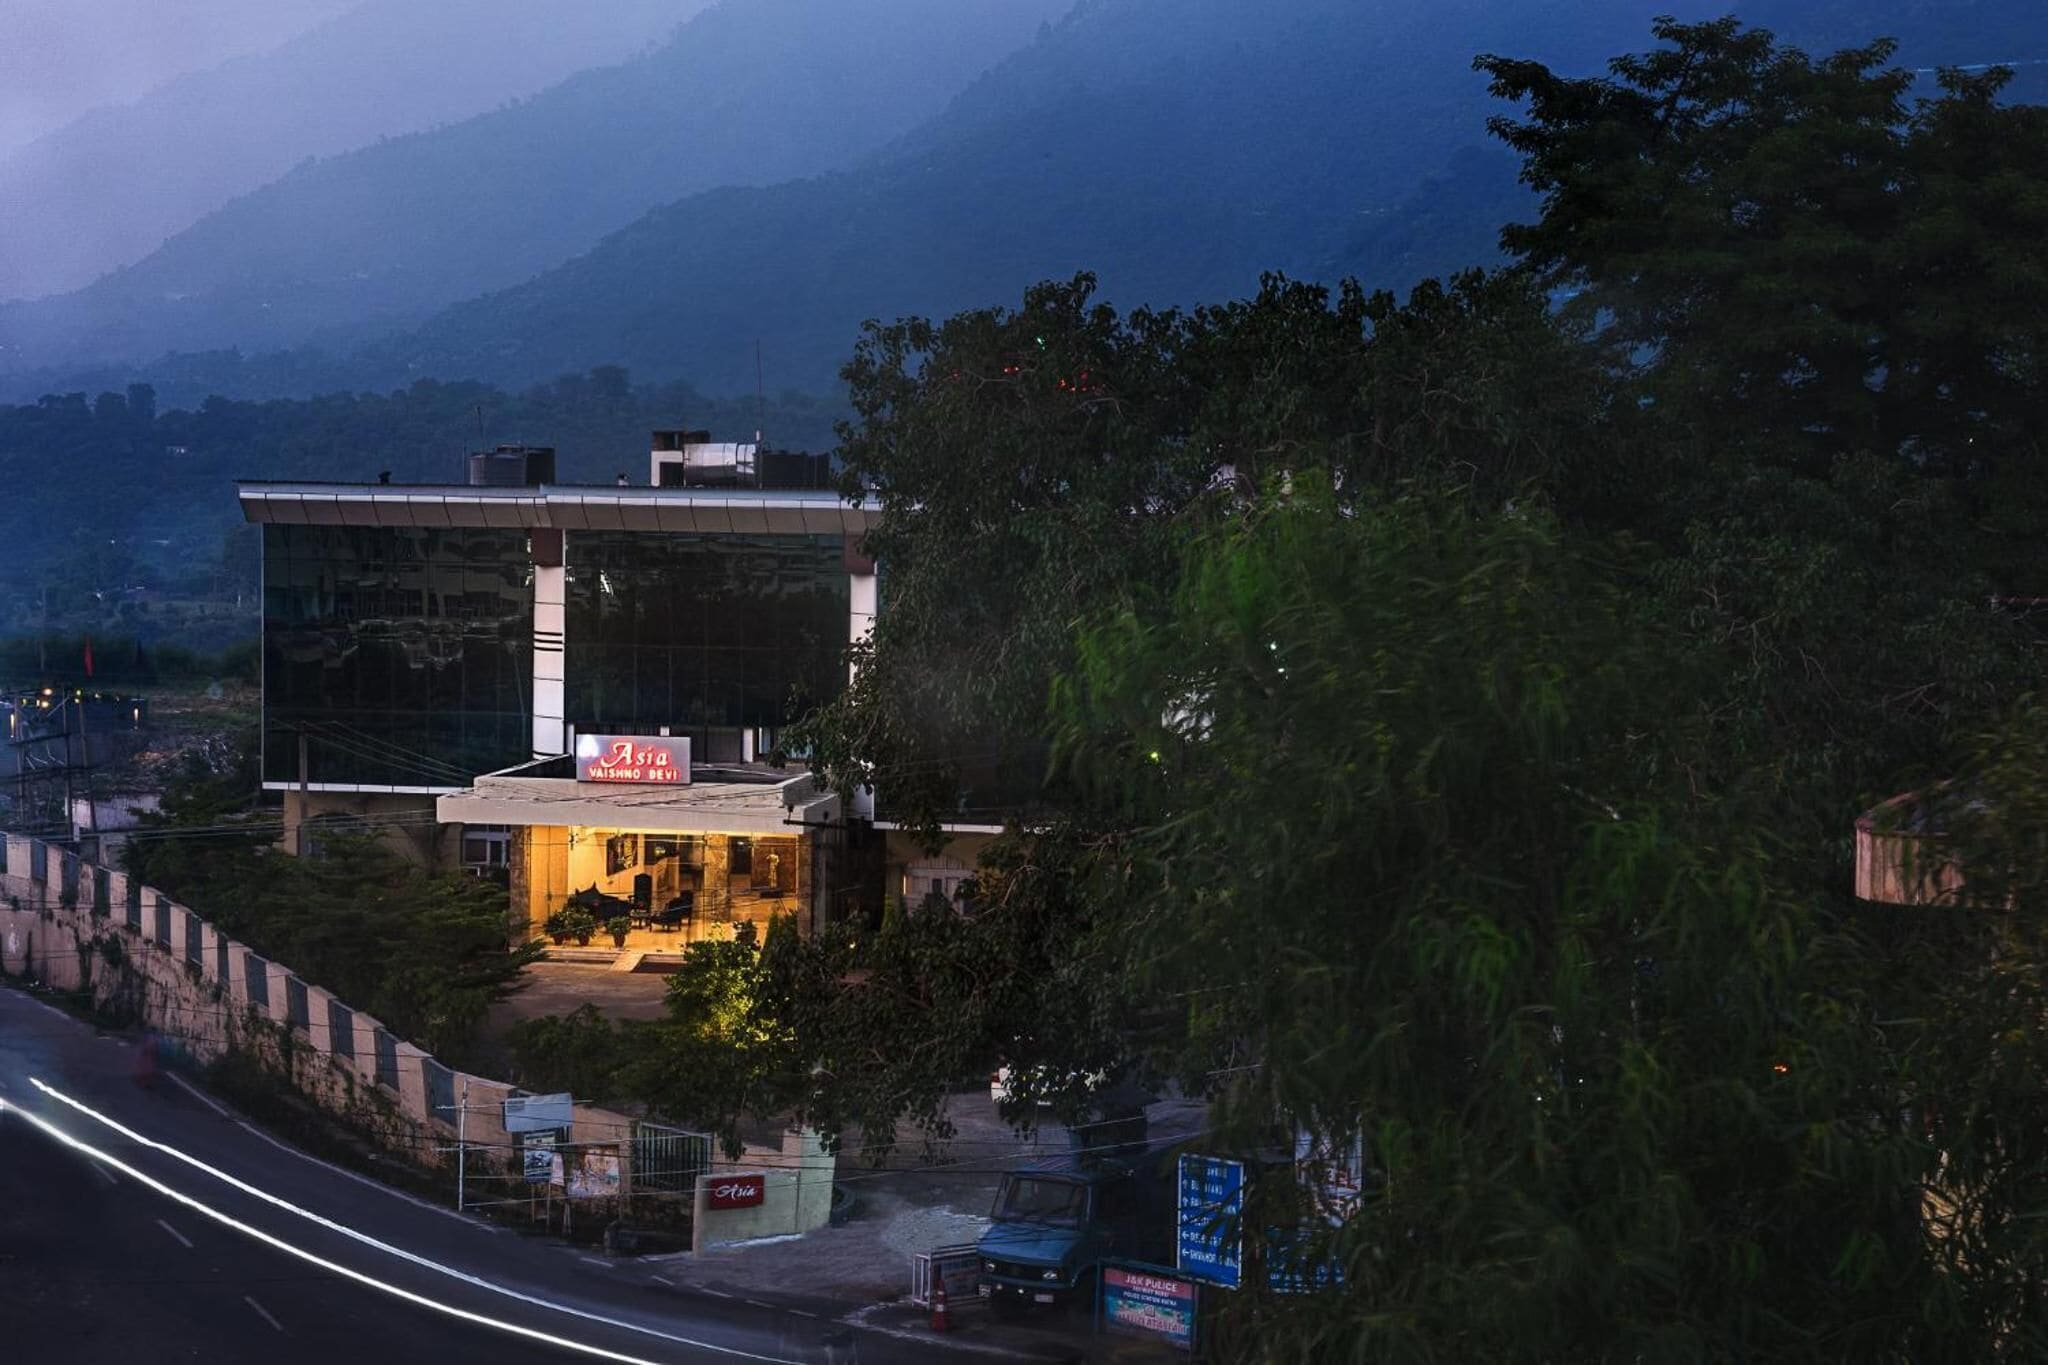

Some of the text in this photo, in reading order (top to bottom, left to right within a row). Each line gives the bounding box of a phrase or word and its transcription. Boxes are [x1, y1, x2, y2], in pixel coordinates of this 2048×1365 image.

[601, 742, 668, 768] Asia
[589, 767, 678, 781] VAISHNO DEVI
[715, 1183, 757, 1200] Asia
[1126, 1274, 1144, 1286] J&K
[1145, 1278, 1178, 1292] POLICE
